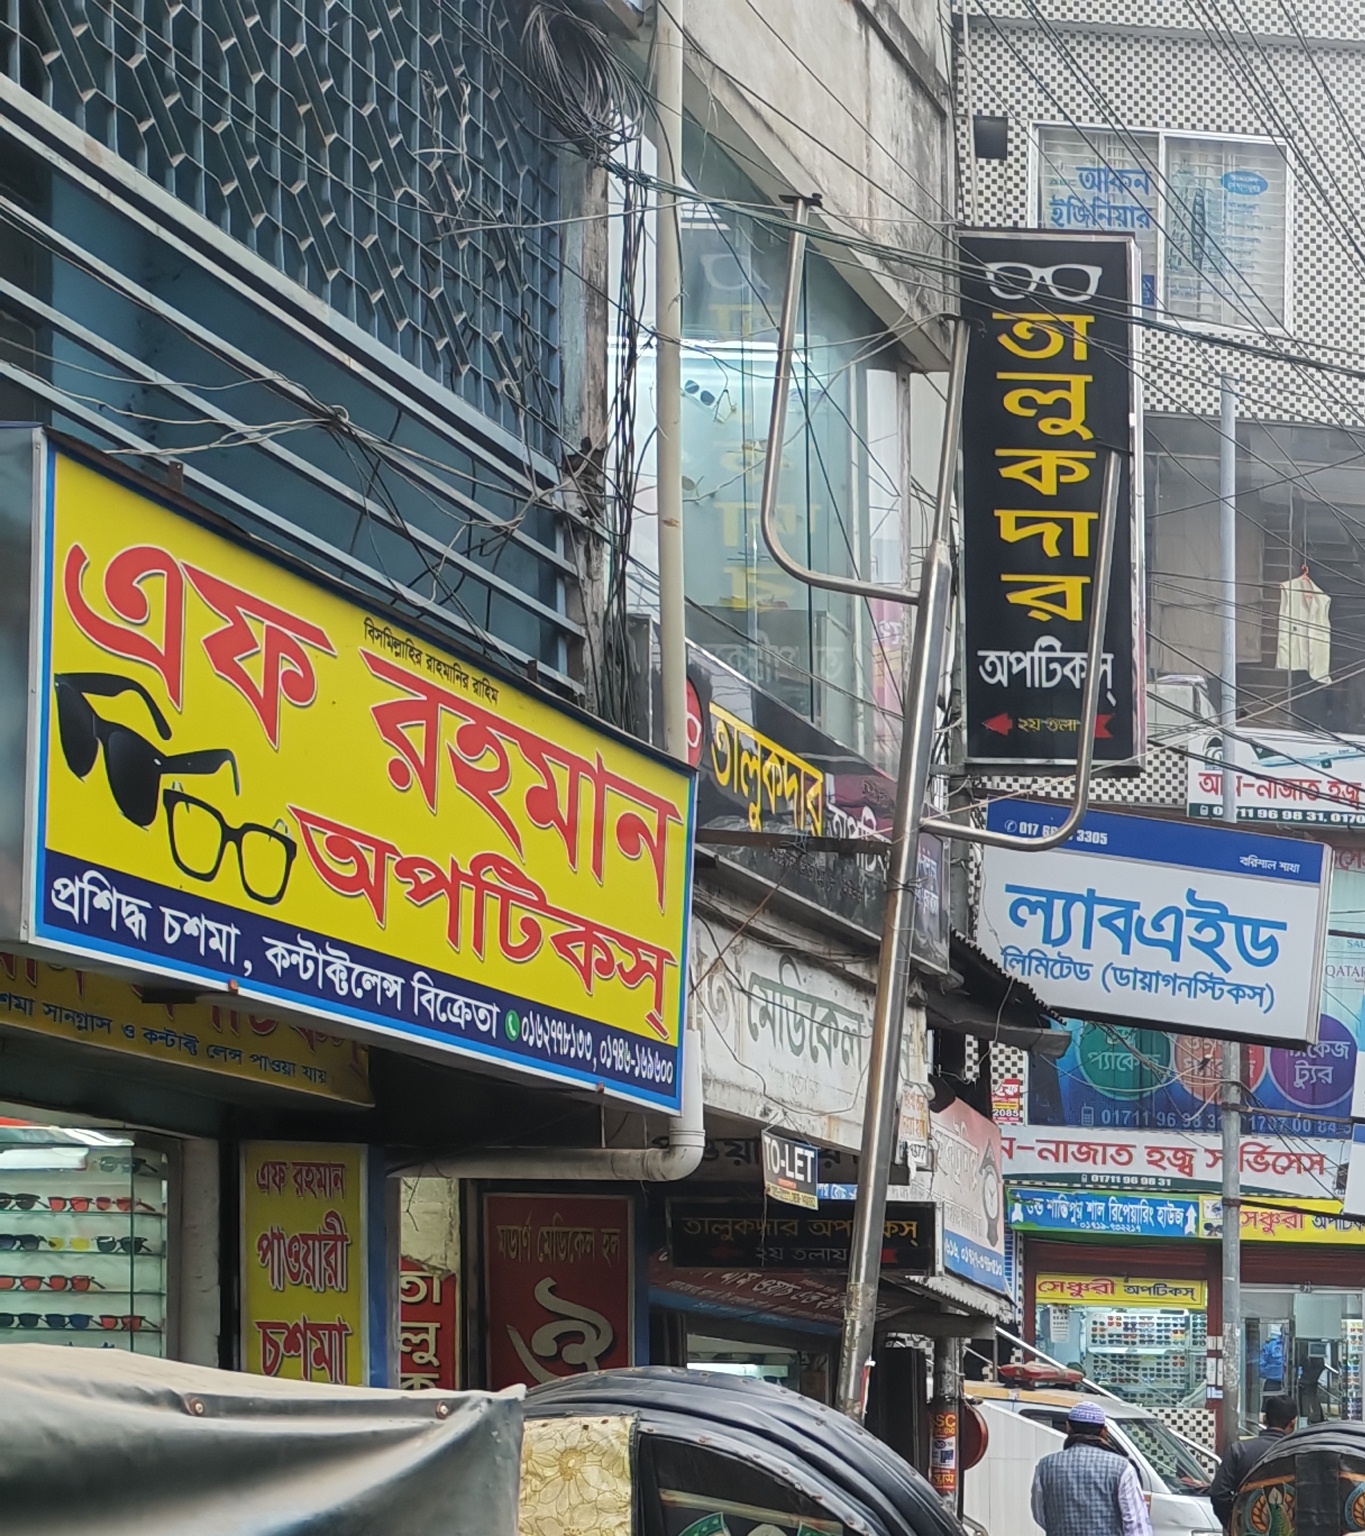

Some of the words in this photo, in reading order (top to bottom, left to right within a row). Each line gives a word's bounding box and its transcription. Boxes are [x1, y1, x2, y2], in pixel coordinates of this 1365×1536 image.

[64, 543, 336, 751] এফ
[358, 648, 684, 914] রহমান
[1019, 822, 1039, 835] 017
[1076, 829, 1108, 845] 3305
[289, 804, 677, 1040] অপটিকস্
[1005, 884, 1287, 974] ল্যাবএইড
[1001, 945, 1094, 981] লিমিটেড
[411, 971, 500, 1039] বিক্রেতা
[122, 1022, 135, 1041] ও
[256, 1160, 287, 1196] এফ
[291, 1160, 346, 1200] রহমান
[763, 1135, 815, 1183] TO-LET
[257, 1209, 351, 1293] পাওয়ারী
[537, 1212, 596, 1264] মেডিকেল
[601, 1228, 622, 1267] হল
[683, 1217, 799, 1242] তালুকদার
[1037, 1277, 1116, 1300] সেঞ্চুরী
[1124, 1282, 1196, 1301] অপটিকস্
[254, 1313, 352, 1384] চশমা
